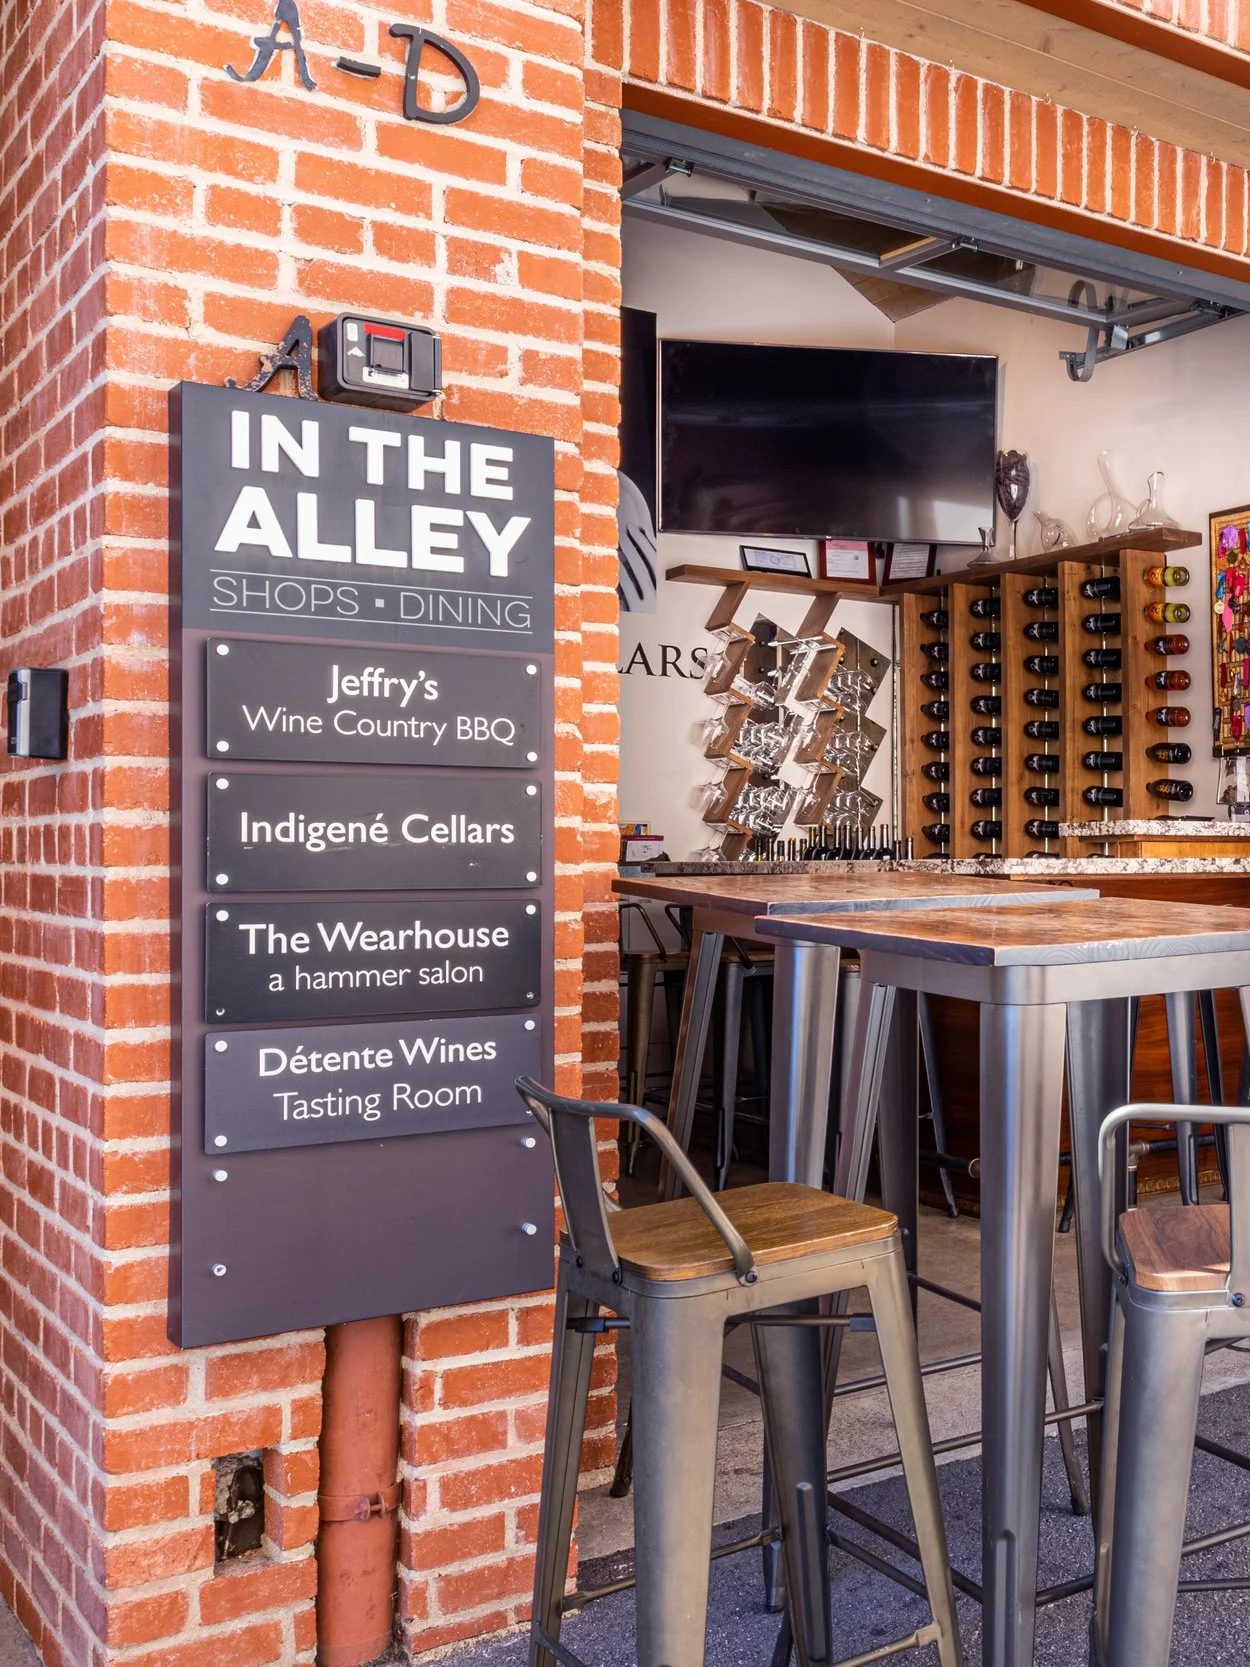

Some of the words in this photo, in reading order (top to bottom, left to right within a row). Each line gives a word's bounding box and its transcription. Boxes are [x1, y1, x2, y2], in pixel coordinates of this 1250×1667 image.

[224, 314, 318, 401] A
[231, 410, 320, 478] IN
[348, 426, 514, 500] THE
[213, 485, 532, 577] ALLEY
[212, 576, 360, 616] SHOPS
[400, 591, 532, 629] DINING
[618, 641, 708, 680] ARS
[327, 664, 439, 708] Jeffry's
[242, 704, 323, 734] Wine
[333, 709, 448, 746] Country
[456, 715, 516, 746] BBQ
[240, 811, 389, 852] Indigené
[401, 813, 516, 844] Cellars
[238, 923, 311, 955] The
[316, 920, 510, 952] Wearhouse
[268, 973, 285, 992] a
[294, 965, 411, 991] hammer
[418, 960, 484, 986] salon
[258, 1045, 394, 1077] Détente
[398, 1037, 498, 1066] Wines
[272, 1087, 382, 1122] Tasting
[392, 1083, 483, 1111] Room
